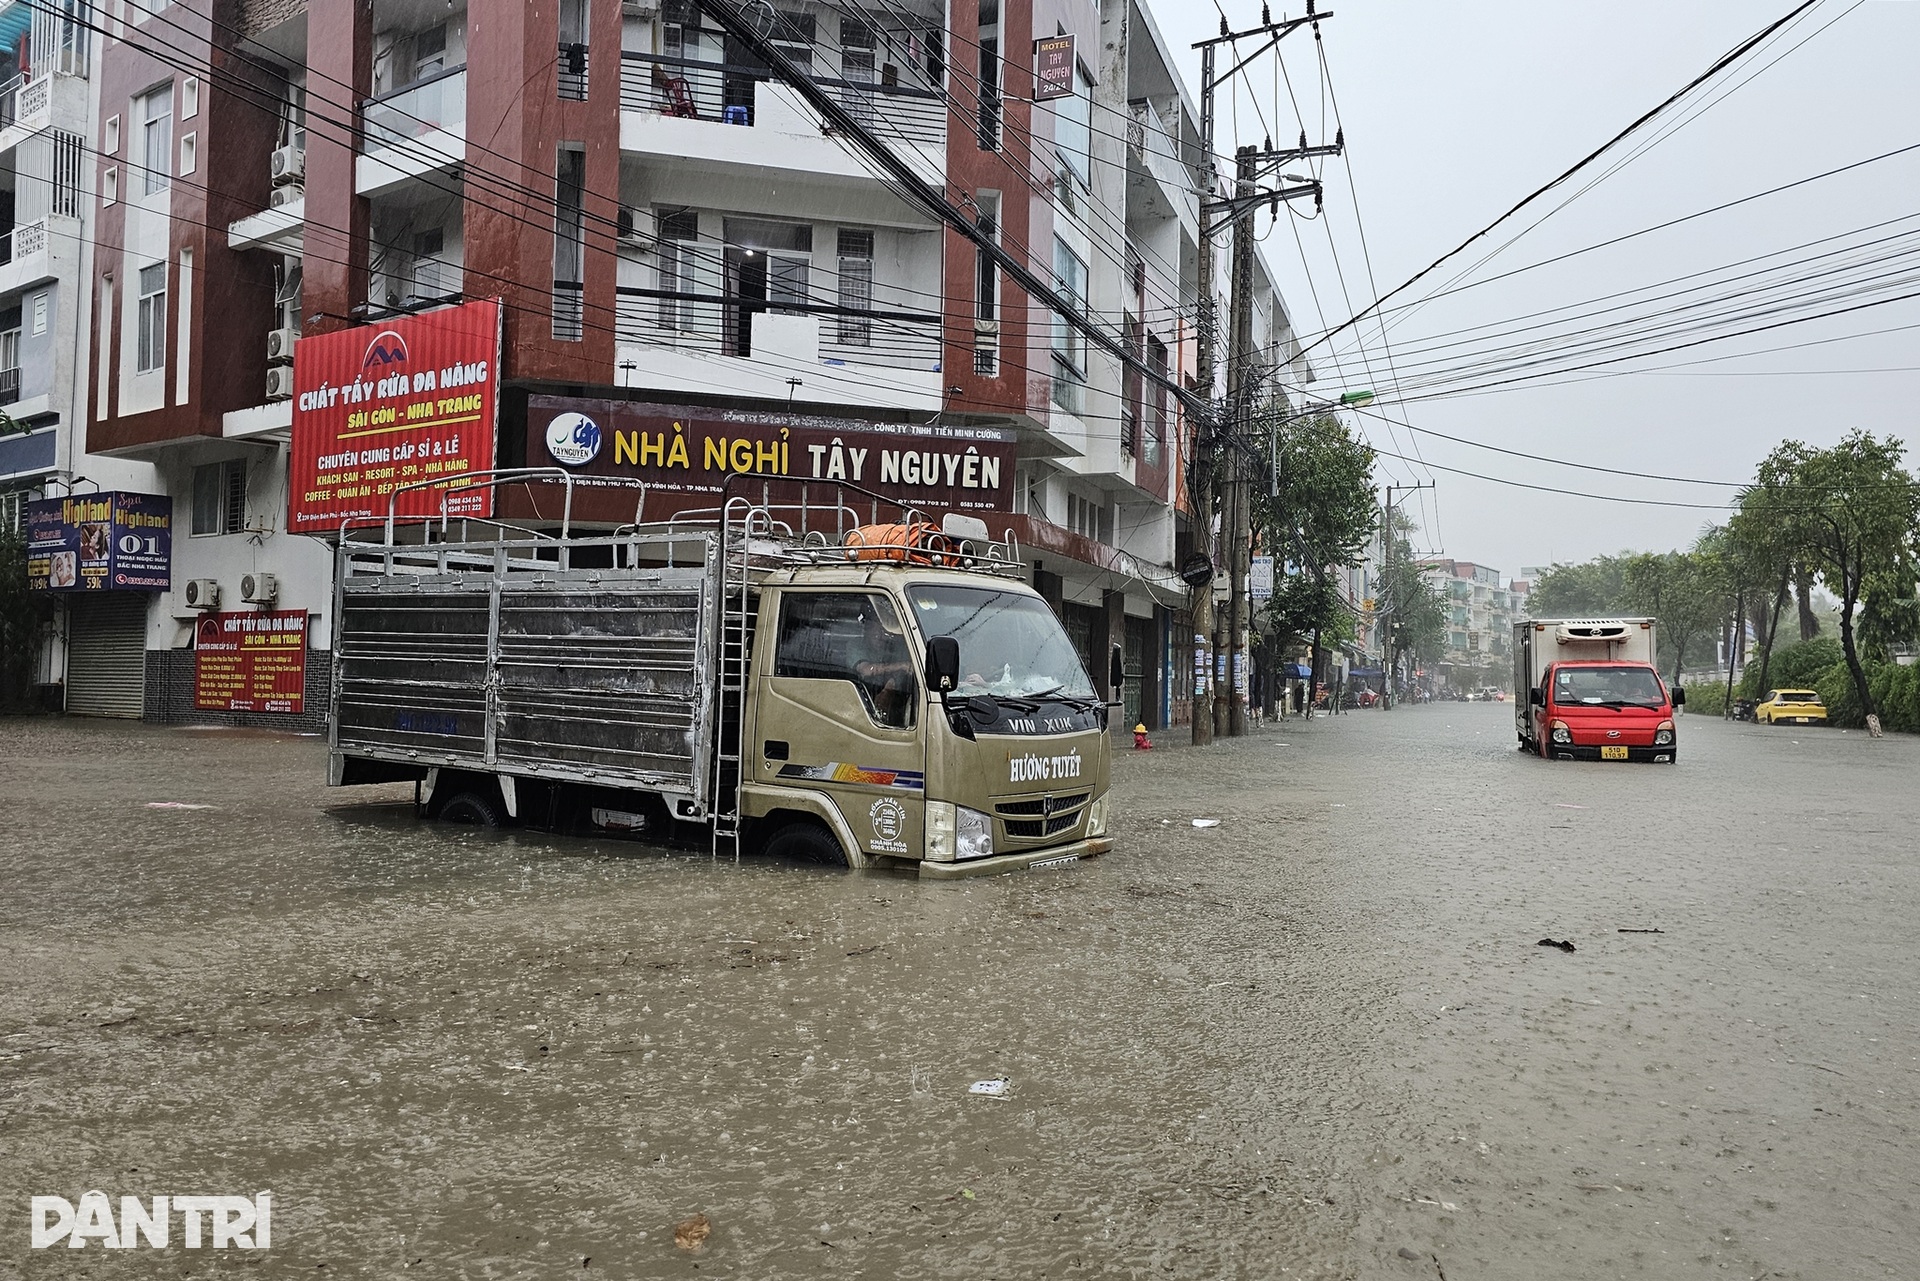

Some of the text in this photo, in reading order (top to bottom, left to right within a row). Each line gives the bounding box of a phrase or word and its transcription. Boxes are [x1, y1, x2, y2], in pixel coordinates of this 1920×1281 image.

[1041, 40, 1071, 51] MOTEL
[1049, 53, 1063, 65] TAY
[1040, 66, 1071, 81] NGUYEN
[299, 361, 488, 412] CHẤT TẨY RỬA ĐA NĂNG
[347, 394, 482, 429] SÀI GÒN NHA TRANG
[874, 422, 1001, 440] CÔNG TY TNHH TIẾN MINH CƯỜNG
[318, 434, 459, 470] CHUYÊN CUNG CẤP SỈ & LẺ
[614, 421, 1000, 490] NHÀ NGHỈ TÂY NGUYÊN
[317, 458, 468, 487] KHÁCH SẠN RESORT SPA NHÀ HÀNG
[304, 491, 331, 502] COFFEE
[377, 479, 393, 495] BẾP
[119, 493, 143, 509] Spa
[63, 497, 111, 528] Highland
[115, 509, 169, 529] Highland
[119, 534, 162, 555] 01
[136, 555, 154, 563] NGỌC
[86, 577, 102, 590] 59k
[224, 614, 241, 632] CHẤT
[269, 635, 281, 645] NHA
[282, 634, 301, 645] TRANG
[1008, 717, 1073, 733] VIN XUK
[1010, 747, 1081, 782] HƯƠNG TUYẾT
